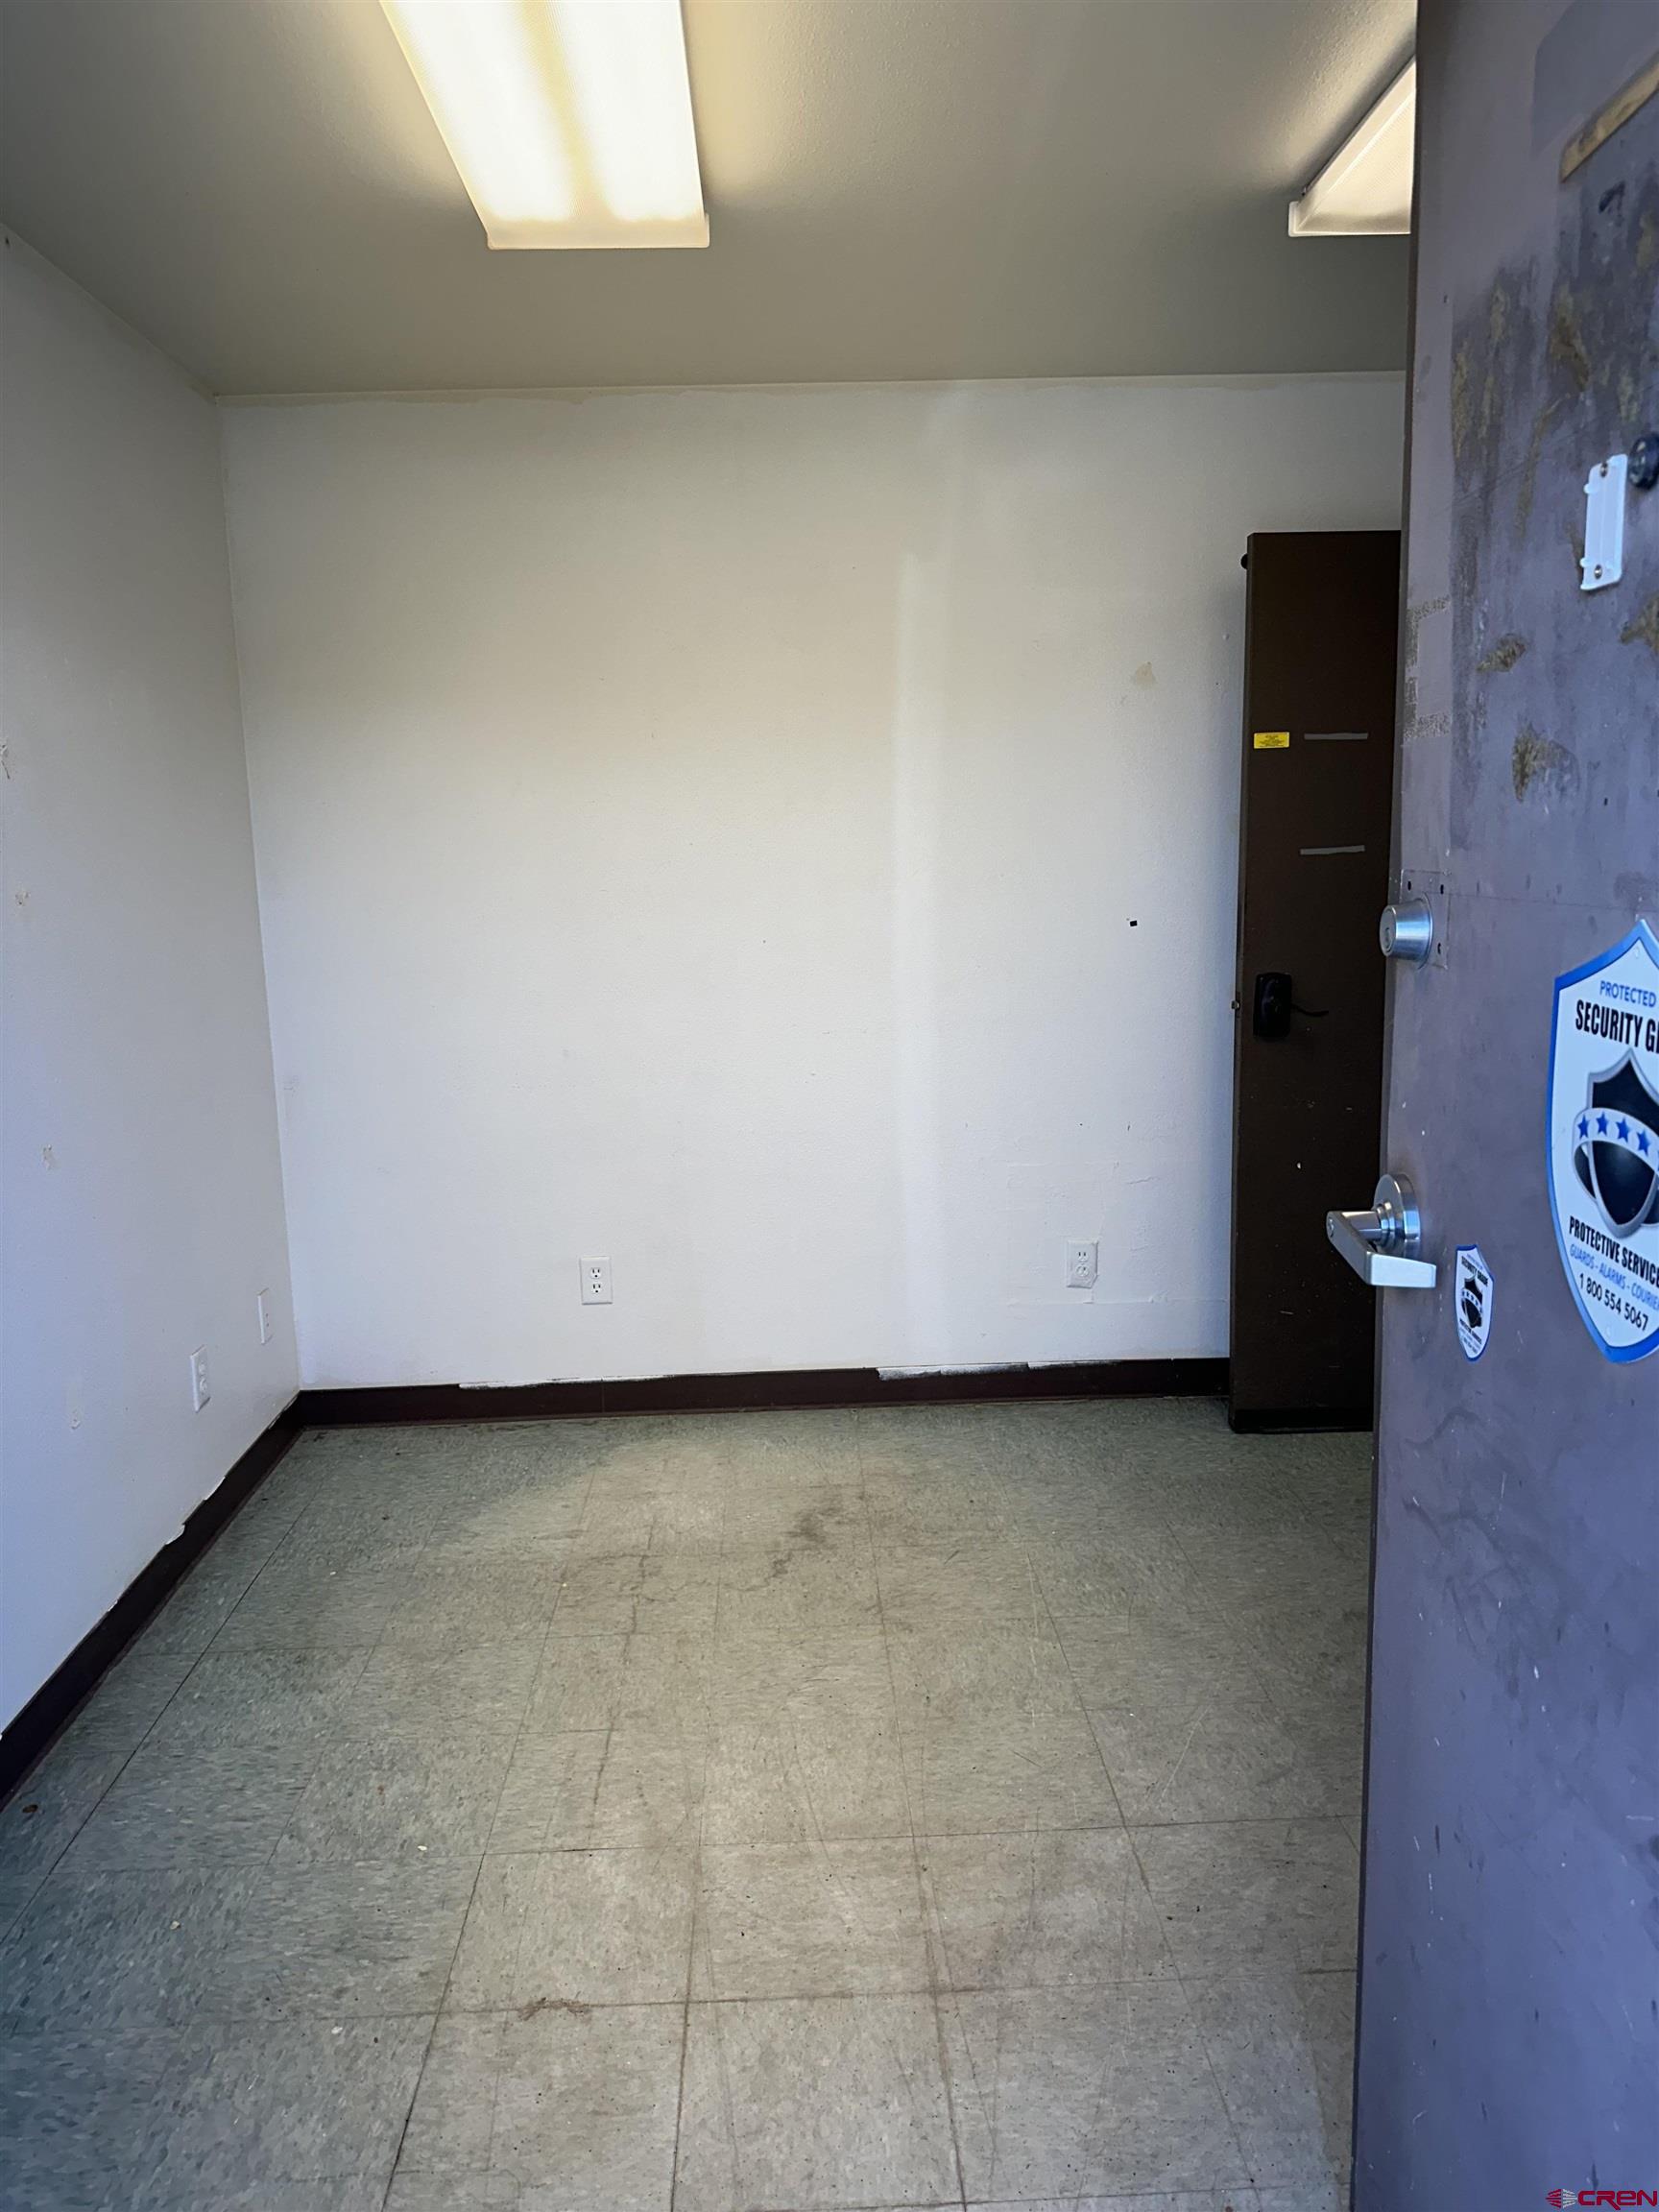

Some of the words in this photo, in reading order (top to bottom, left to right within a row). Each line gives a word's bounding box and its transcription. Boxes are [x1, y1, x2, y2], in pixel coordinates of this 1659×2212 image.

[1599, 980, 1657, 1008] PROTECTED
[1575, 999, 1643, 1047] SECURITY
[1646, 1018, 1659, 1054] G
[1569, 1215, 1621, 1263] PROTECTIVE
[1570, 1243, 1595, 1269] GUARDS
[1599, 1262, 1626, 1289] ALARMS
[1631, 1282, 1659, 1310] COURIE
[1579, 1272, 1584, 1289] 1
[1586, 1277, 1602, 1301] 800
[1604, 1288, 1622, 1314] 554
[1624, 1302, 1648, 1331] 5067
